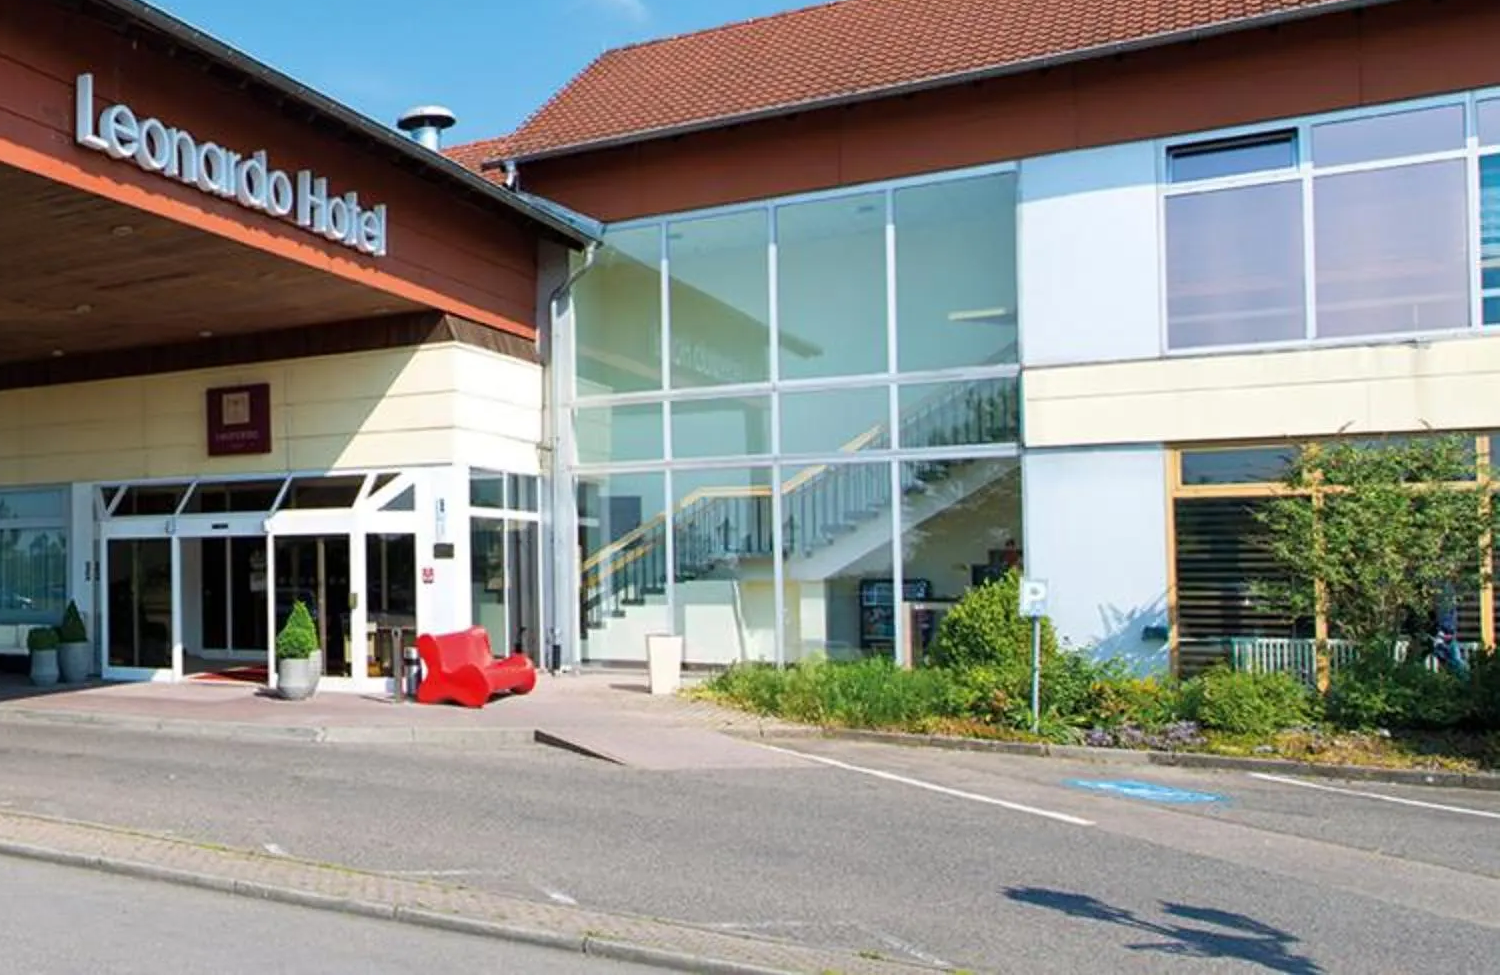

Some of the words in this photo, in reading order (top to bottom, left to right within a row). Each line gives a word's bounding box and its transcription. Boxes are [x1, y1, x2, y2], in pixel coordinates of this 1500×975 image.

[76, 72, 293, 216] Leonardo
[296, 170, 387, 257] Hotel
[1023, 581, 1047, 611] P
